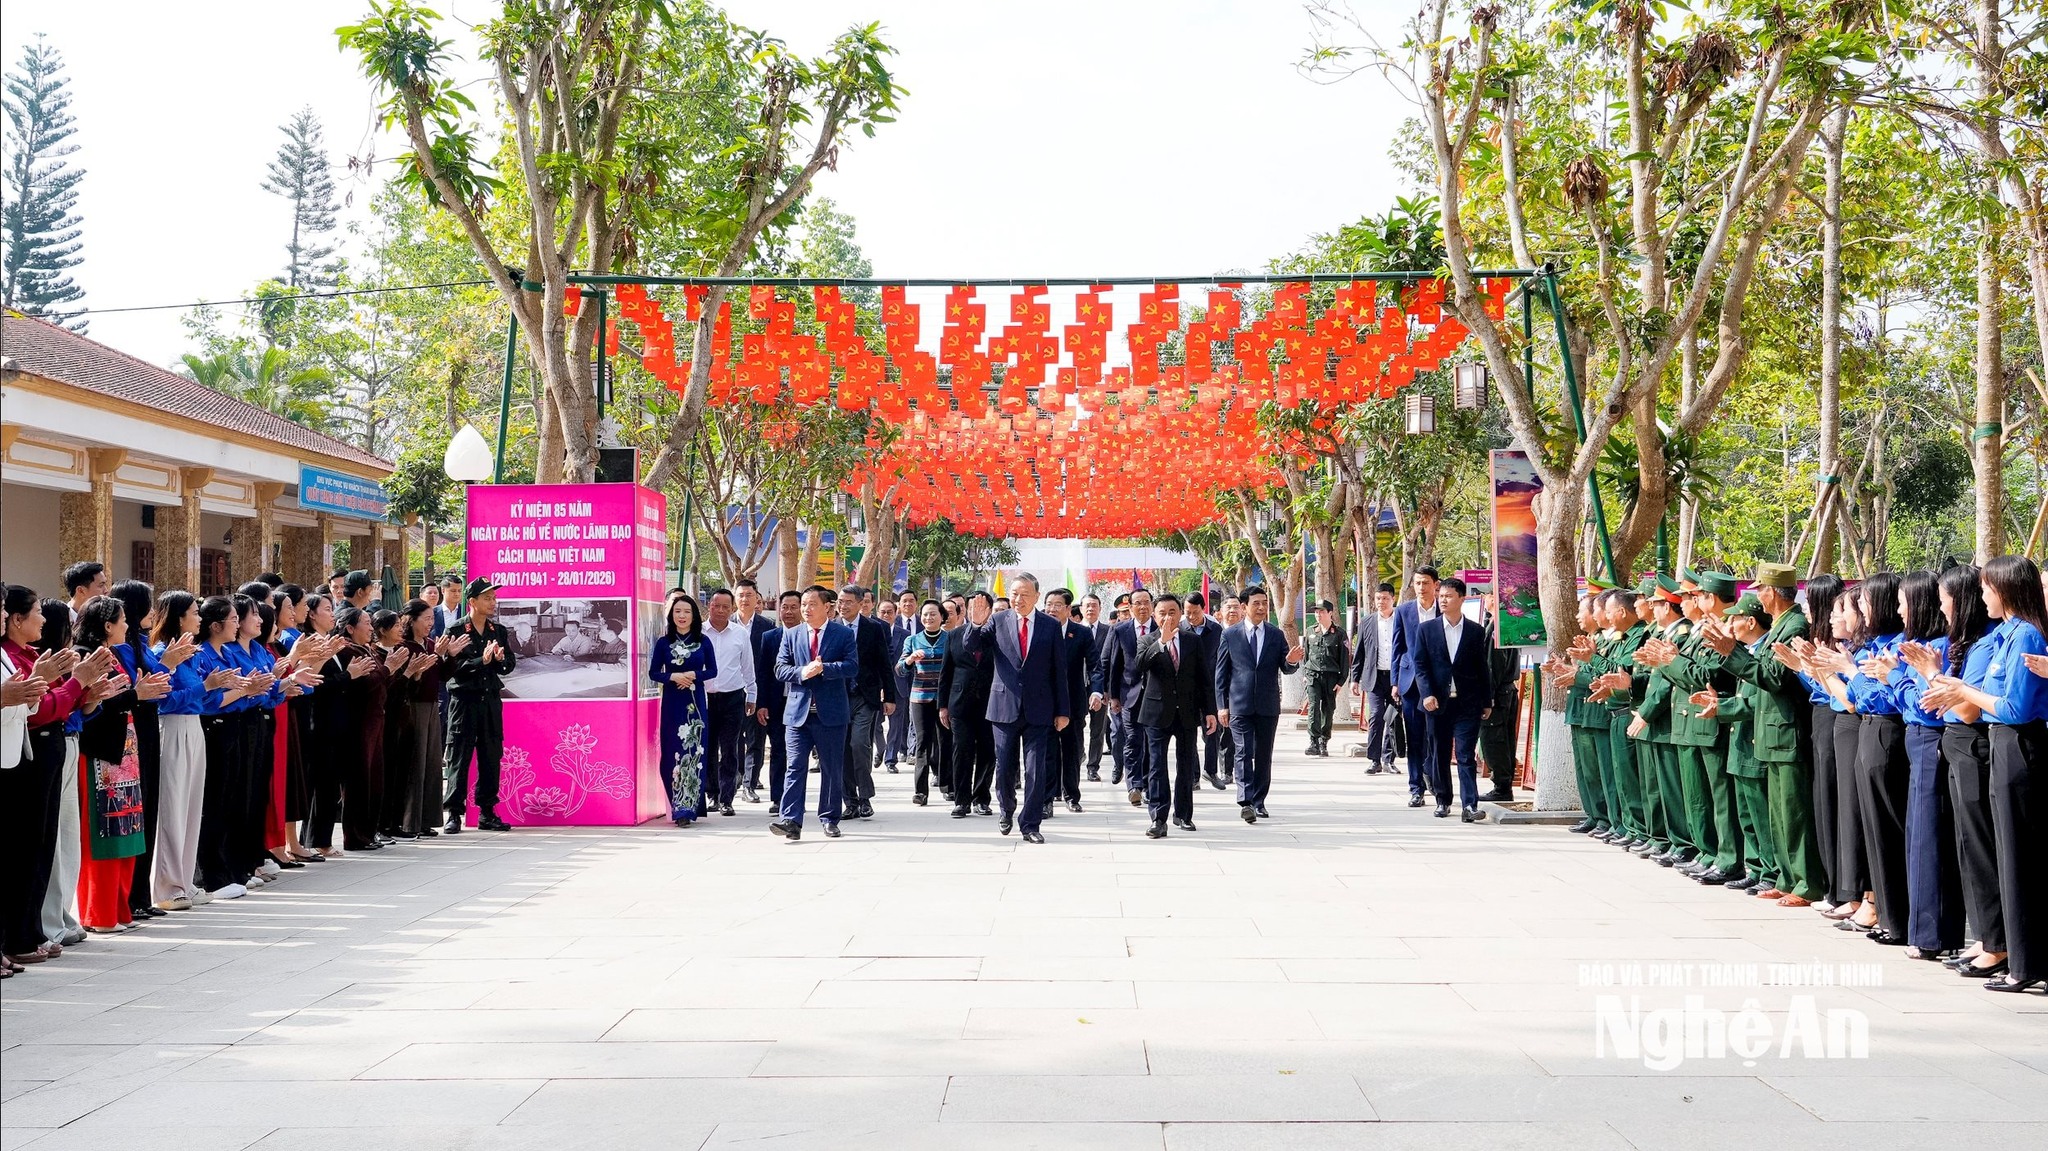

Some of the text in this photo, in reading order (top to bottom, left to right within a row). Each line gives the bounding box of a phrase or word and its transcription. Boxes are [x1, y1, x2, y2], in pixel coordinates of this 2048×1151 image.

[511, 499, 591, 520] KỶ NIỆM 85 NĂM
[471, 524, 498, 541] NGÀY
[501, 524, 520, 540] BÁC
[554, 523, 580, 540] NƯỚC
[583, 523, 608, 539] LÃNH
[611, 524, 631, 542] ĐẠO
[498, 546, 605, 566] CÁCH MẠNG VIỆT NAM
[491, 572, 547, 586] (28/01/1941
[558, 570, 616, 586] 28/01/2026)
